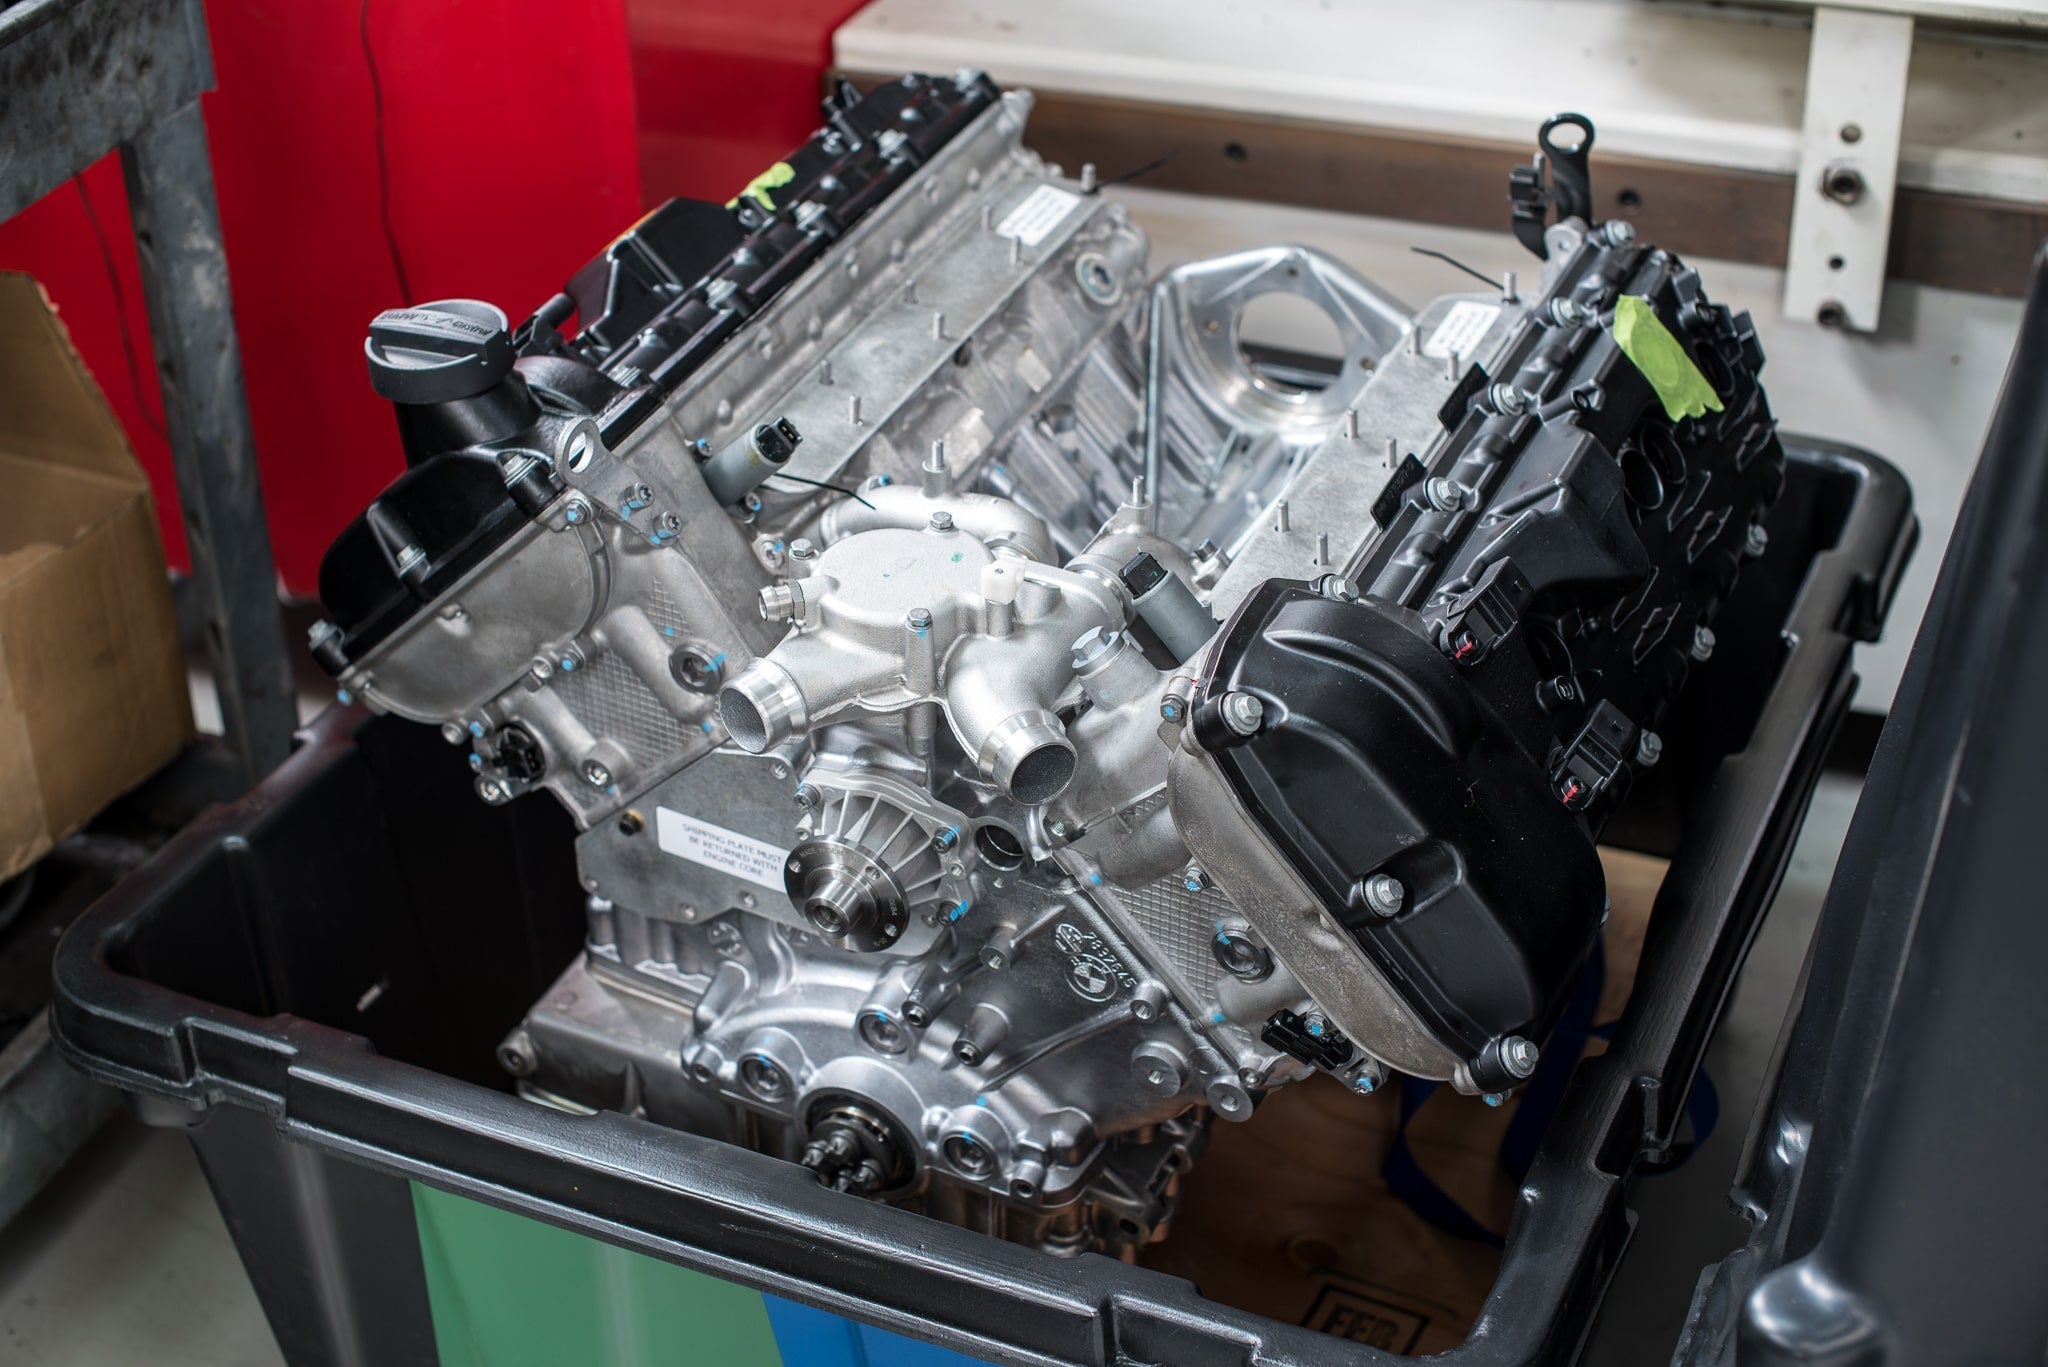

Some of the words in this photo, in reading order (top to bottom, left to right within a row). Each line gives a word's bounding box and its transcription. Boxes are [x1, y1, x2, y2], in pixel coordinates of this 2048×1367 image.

[683, 823, 725, 844] SHIPPING
[727, 839, 753, 853] PLATE
[757, 849, 782, 863] MUST
[689, 836, 699, 844] BE
[703, 841, 750, 862] RETURNED
[753, 859, 778, 872] WITH
[704, 851, 736, 867] ENGINE
[739, 863, 763, 876] CORE
